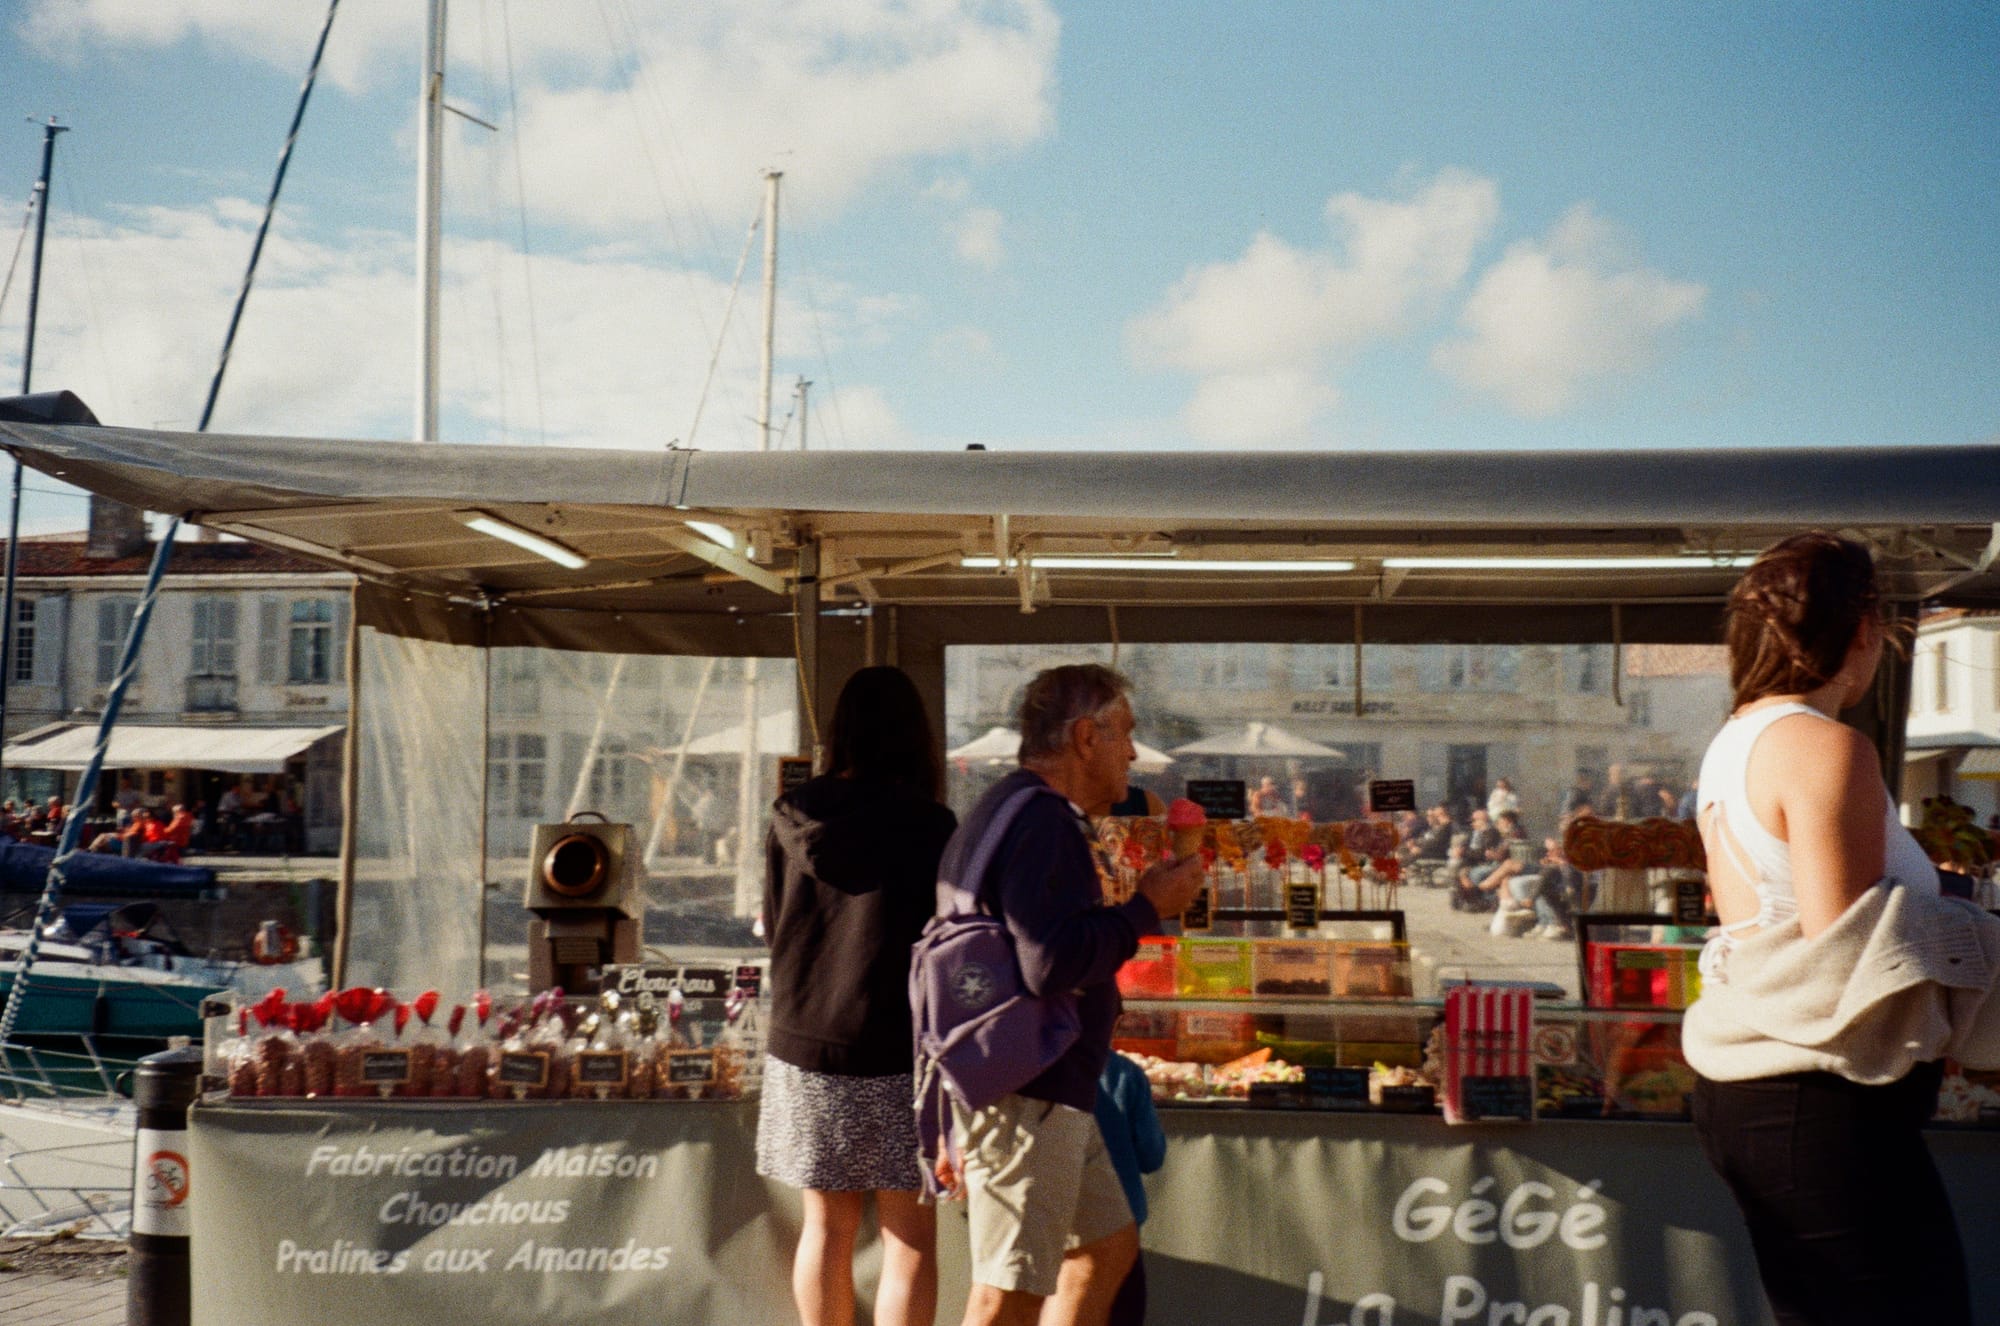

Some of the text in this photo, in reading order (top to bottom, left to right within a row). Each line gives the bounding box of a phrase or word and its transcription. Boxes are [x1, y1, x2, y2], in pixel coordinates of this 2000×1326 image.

[305, 1145, 658, 1179] Fabrication Maison
[378, 1191, 571, 1226] Chouchous
[1393, 1175, 1609, 1250] GéGé
[276, 1238, 672, 1274] Pralines aux Amandes
[1303, 1270, 1397, 1326] La
